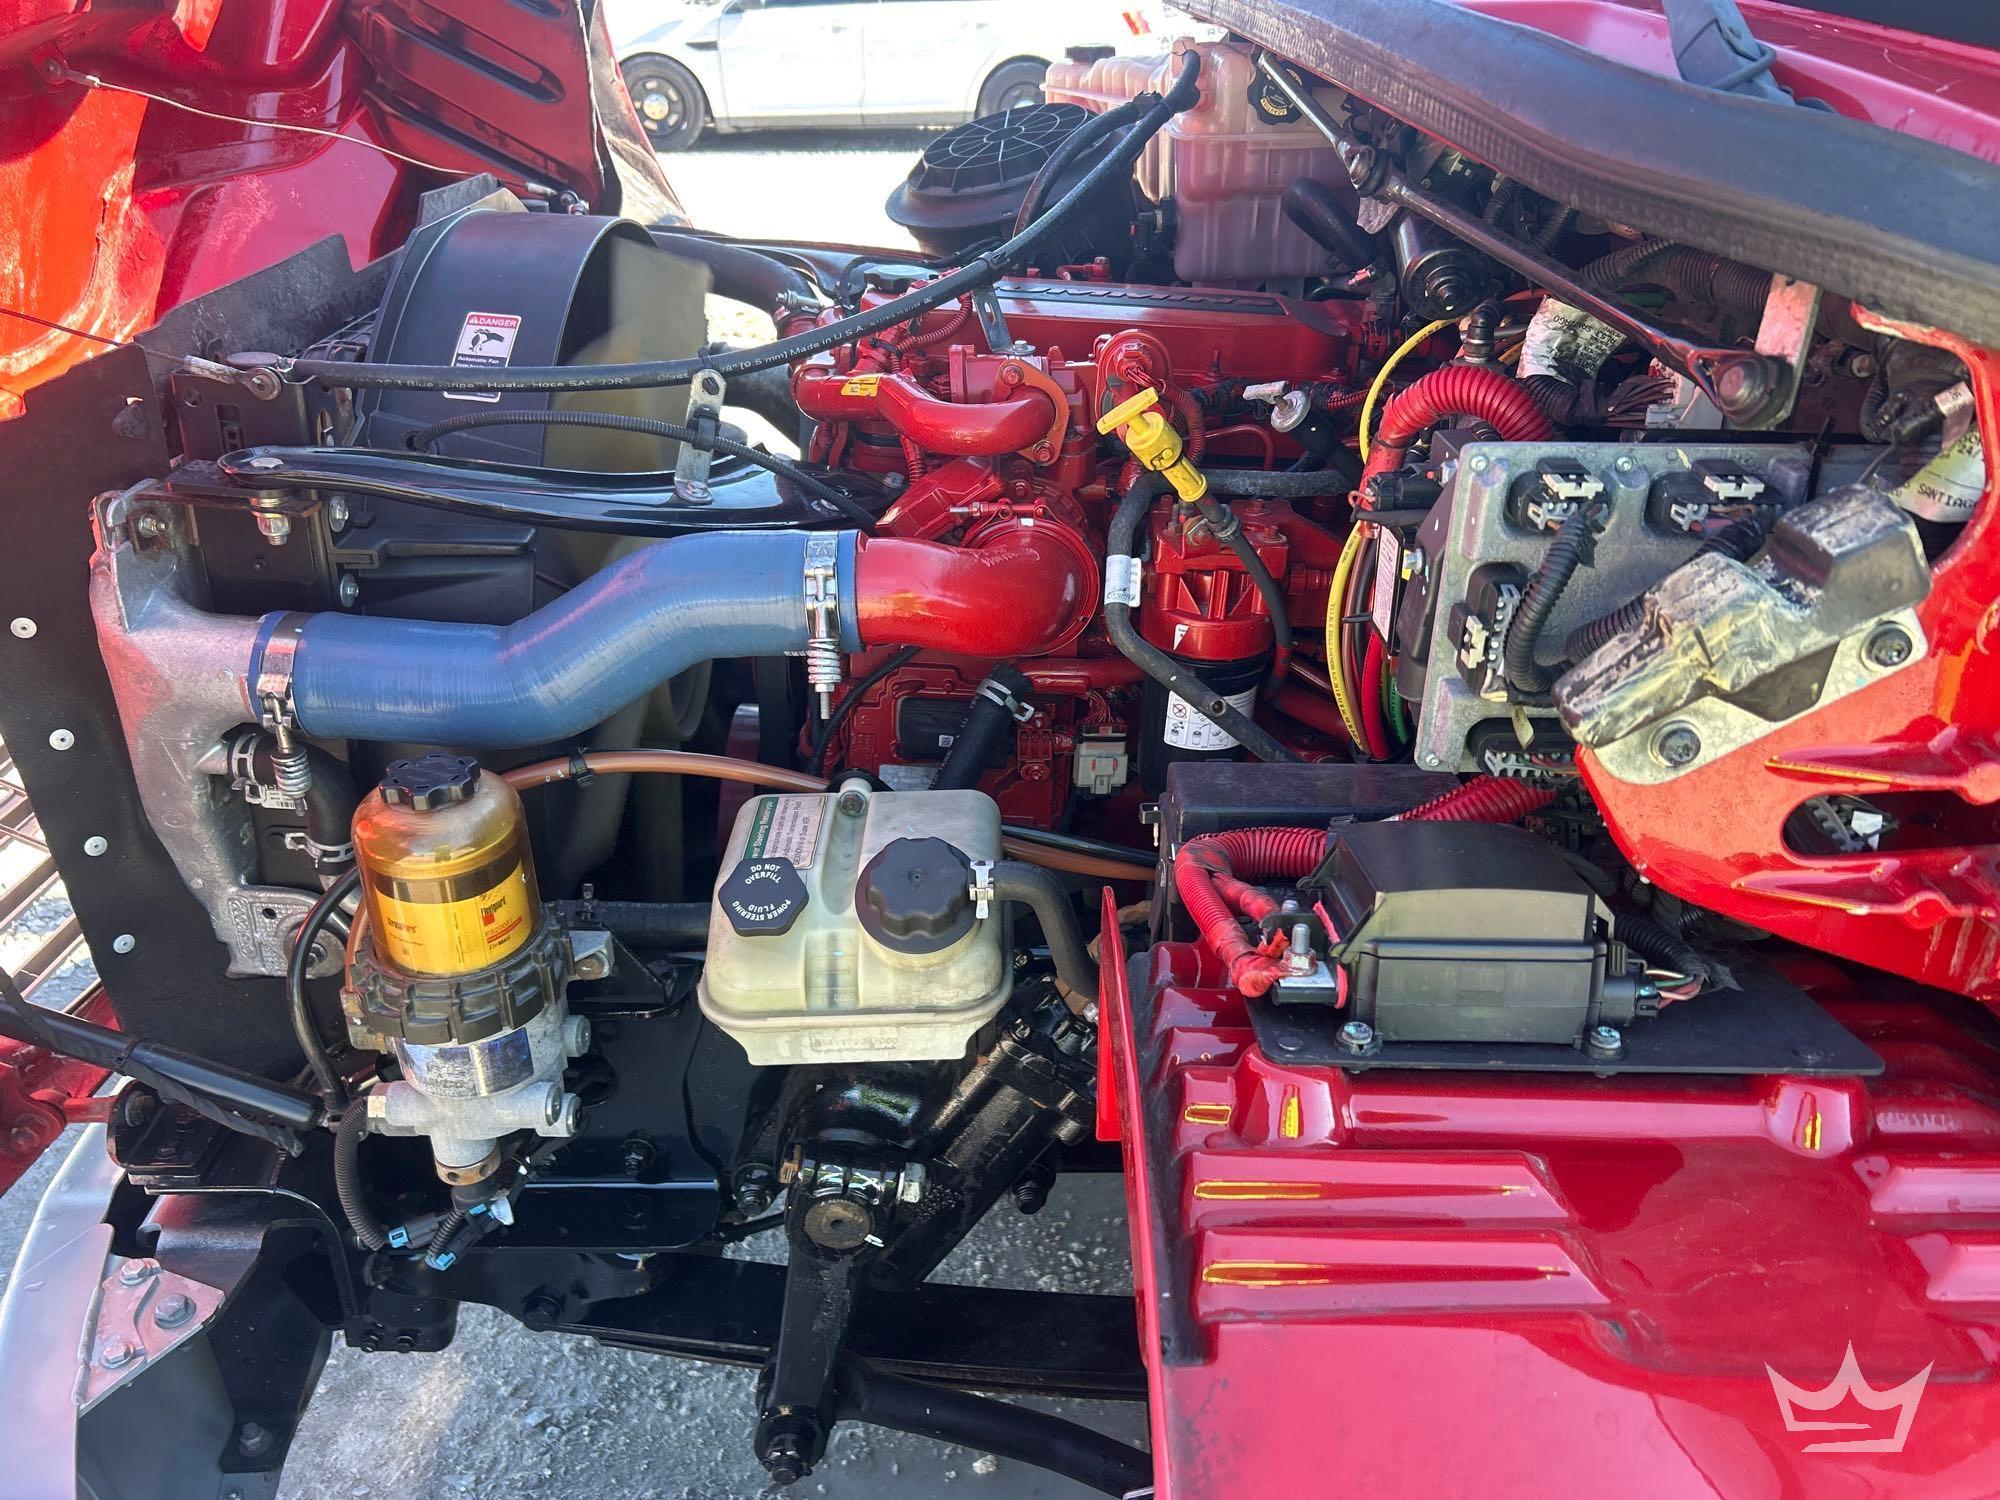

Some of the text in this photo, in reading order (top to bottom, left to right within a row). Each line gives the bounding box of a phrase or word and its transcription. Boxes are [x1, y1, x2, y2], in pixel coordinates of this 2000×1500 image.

[479, 317, 517, 328] DANGER
[407, 380, 434, 388] Blue
[790, 342, 820, 356] Made
[822, 336, 832, 345] in
[1918, 483, 1976, 508] SANTIAG
[750, 863, 781, 873] DO NOT
[745, 871, 781, 885] OVERFILL
[732, 899, 792, 921] POWER STEERING
[748, 903, 775, 913] FLUID
